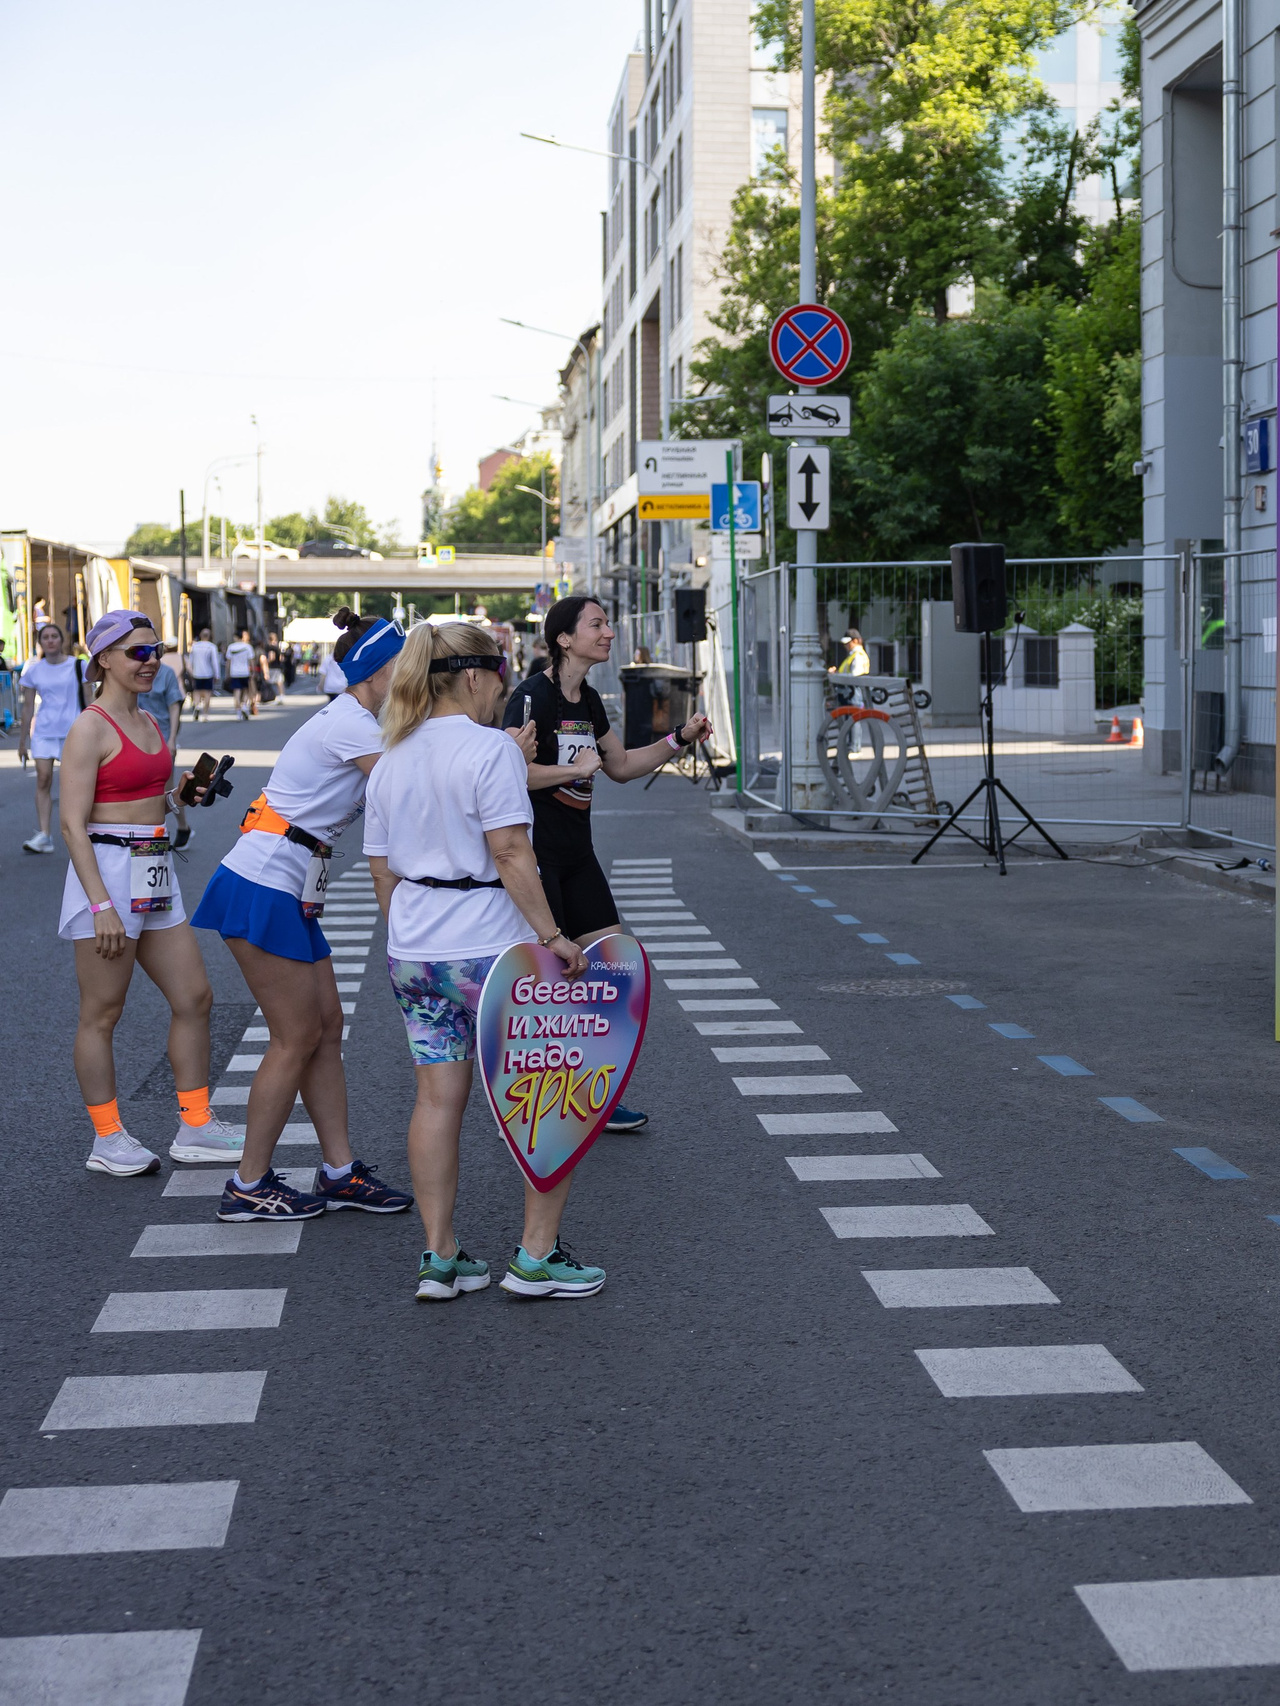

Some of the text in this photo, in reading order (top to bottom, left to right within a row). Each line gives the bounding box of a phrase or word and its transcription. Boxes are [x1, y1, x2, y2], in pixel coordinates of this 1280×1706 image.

[1247, 428, 1259, 455] 30
[147, 866, 169, 887] 371
[512, 974, 618, 1004] бегать
[508, 1013, 610, 1038] и жить
[506, 1040, 584, 1073] надо
